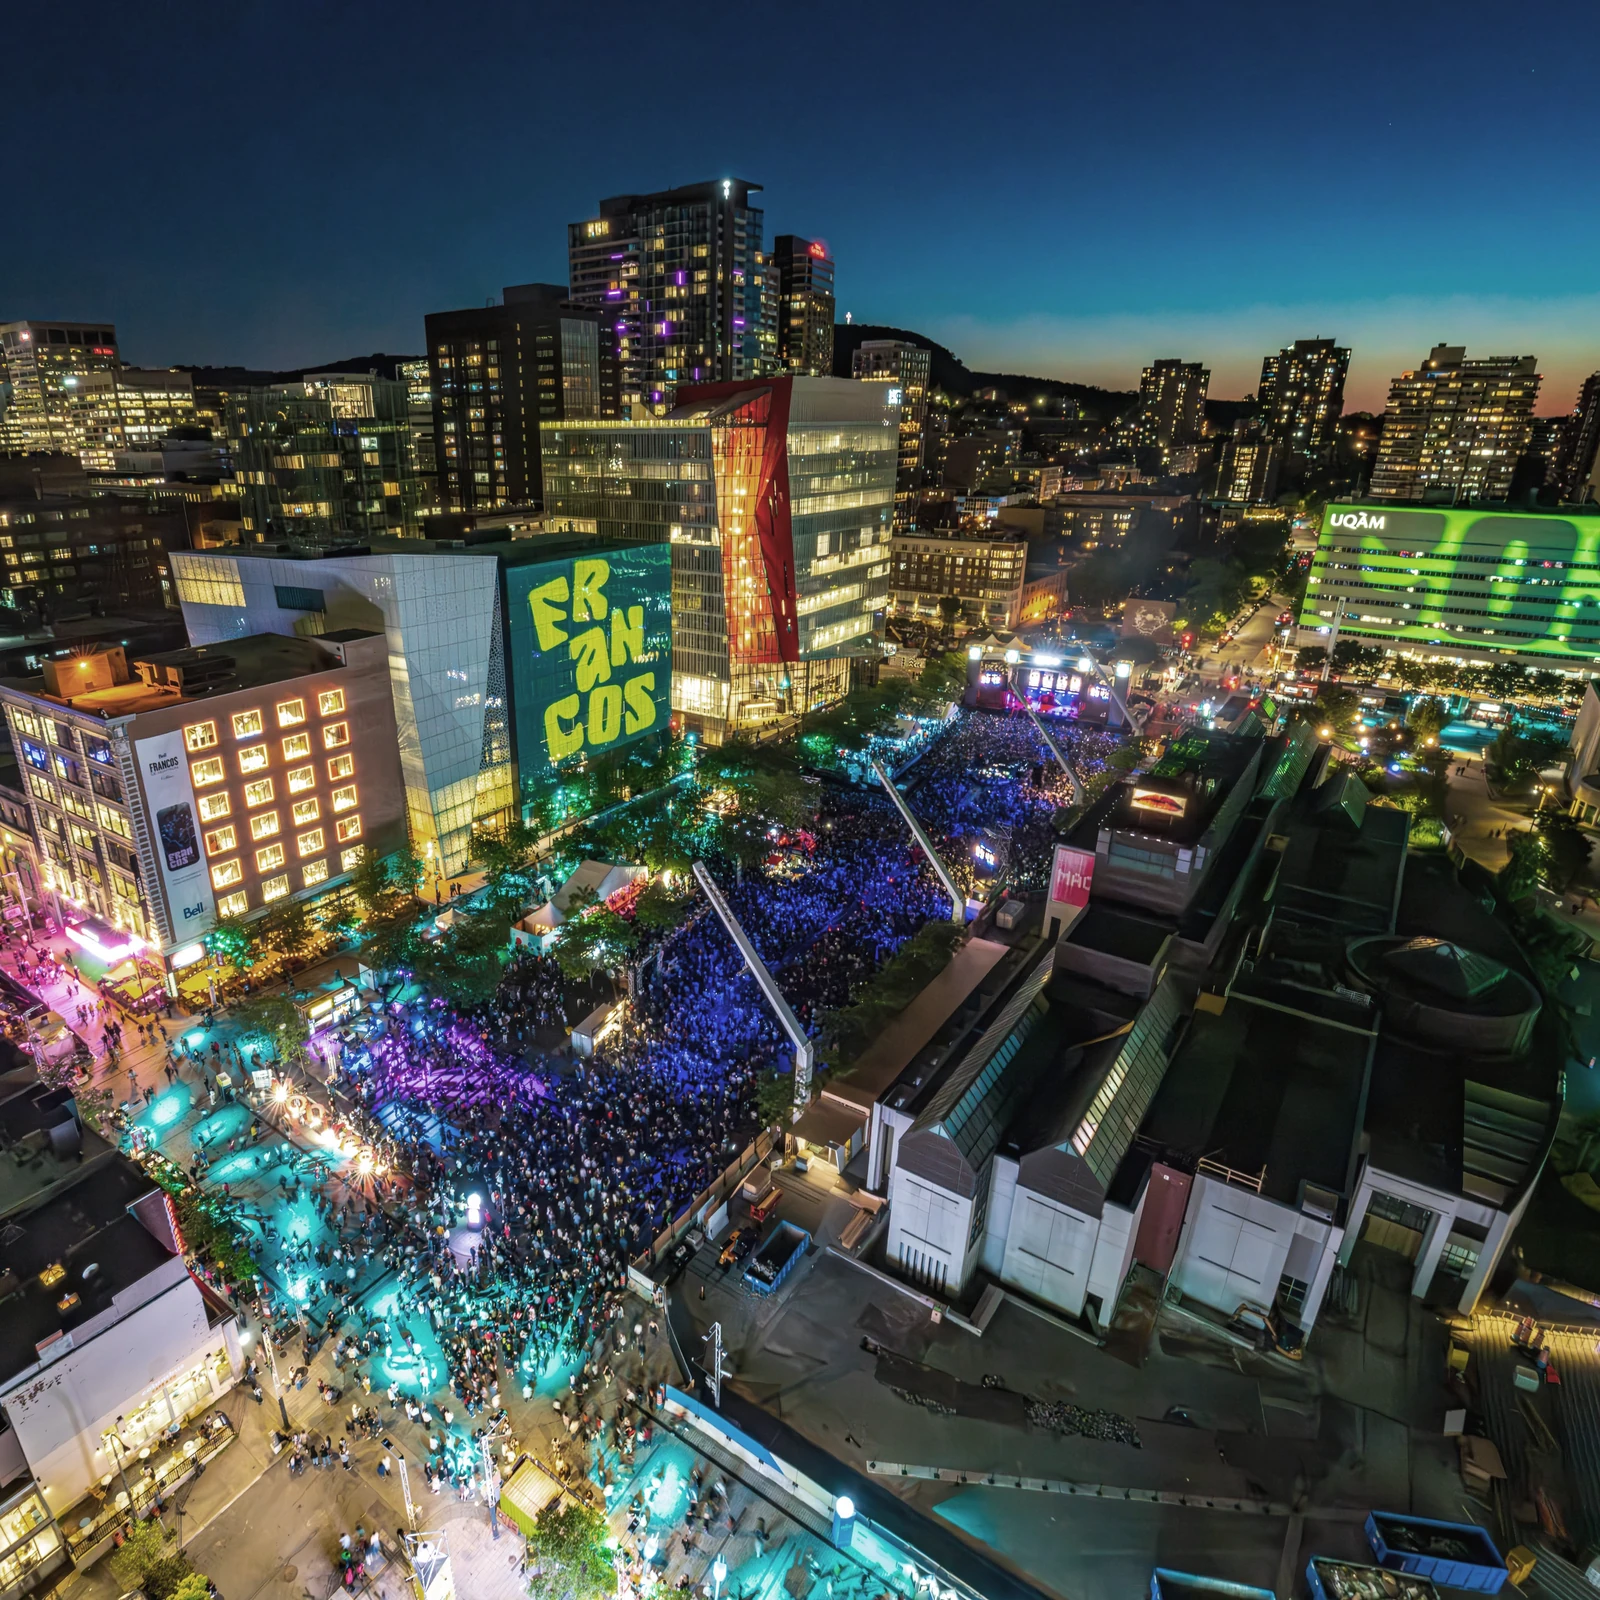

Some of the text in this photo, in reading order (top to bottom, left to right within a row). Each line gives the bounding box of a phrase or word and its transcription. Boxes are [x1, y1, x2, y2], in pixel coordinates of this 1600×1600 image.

[149, 757, 179, 773] FRANCOS
[1056, 869, 1092, 890] MAC
[183, 902, 204, 919] Bell
